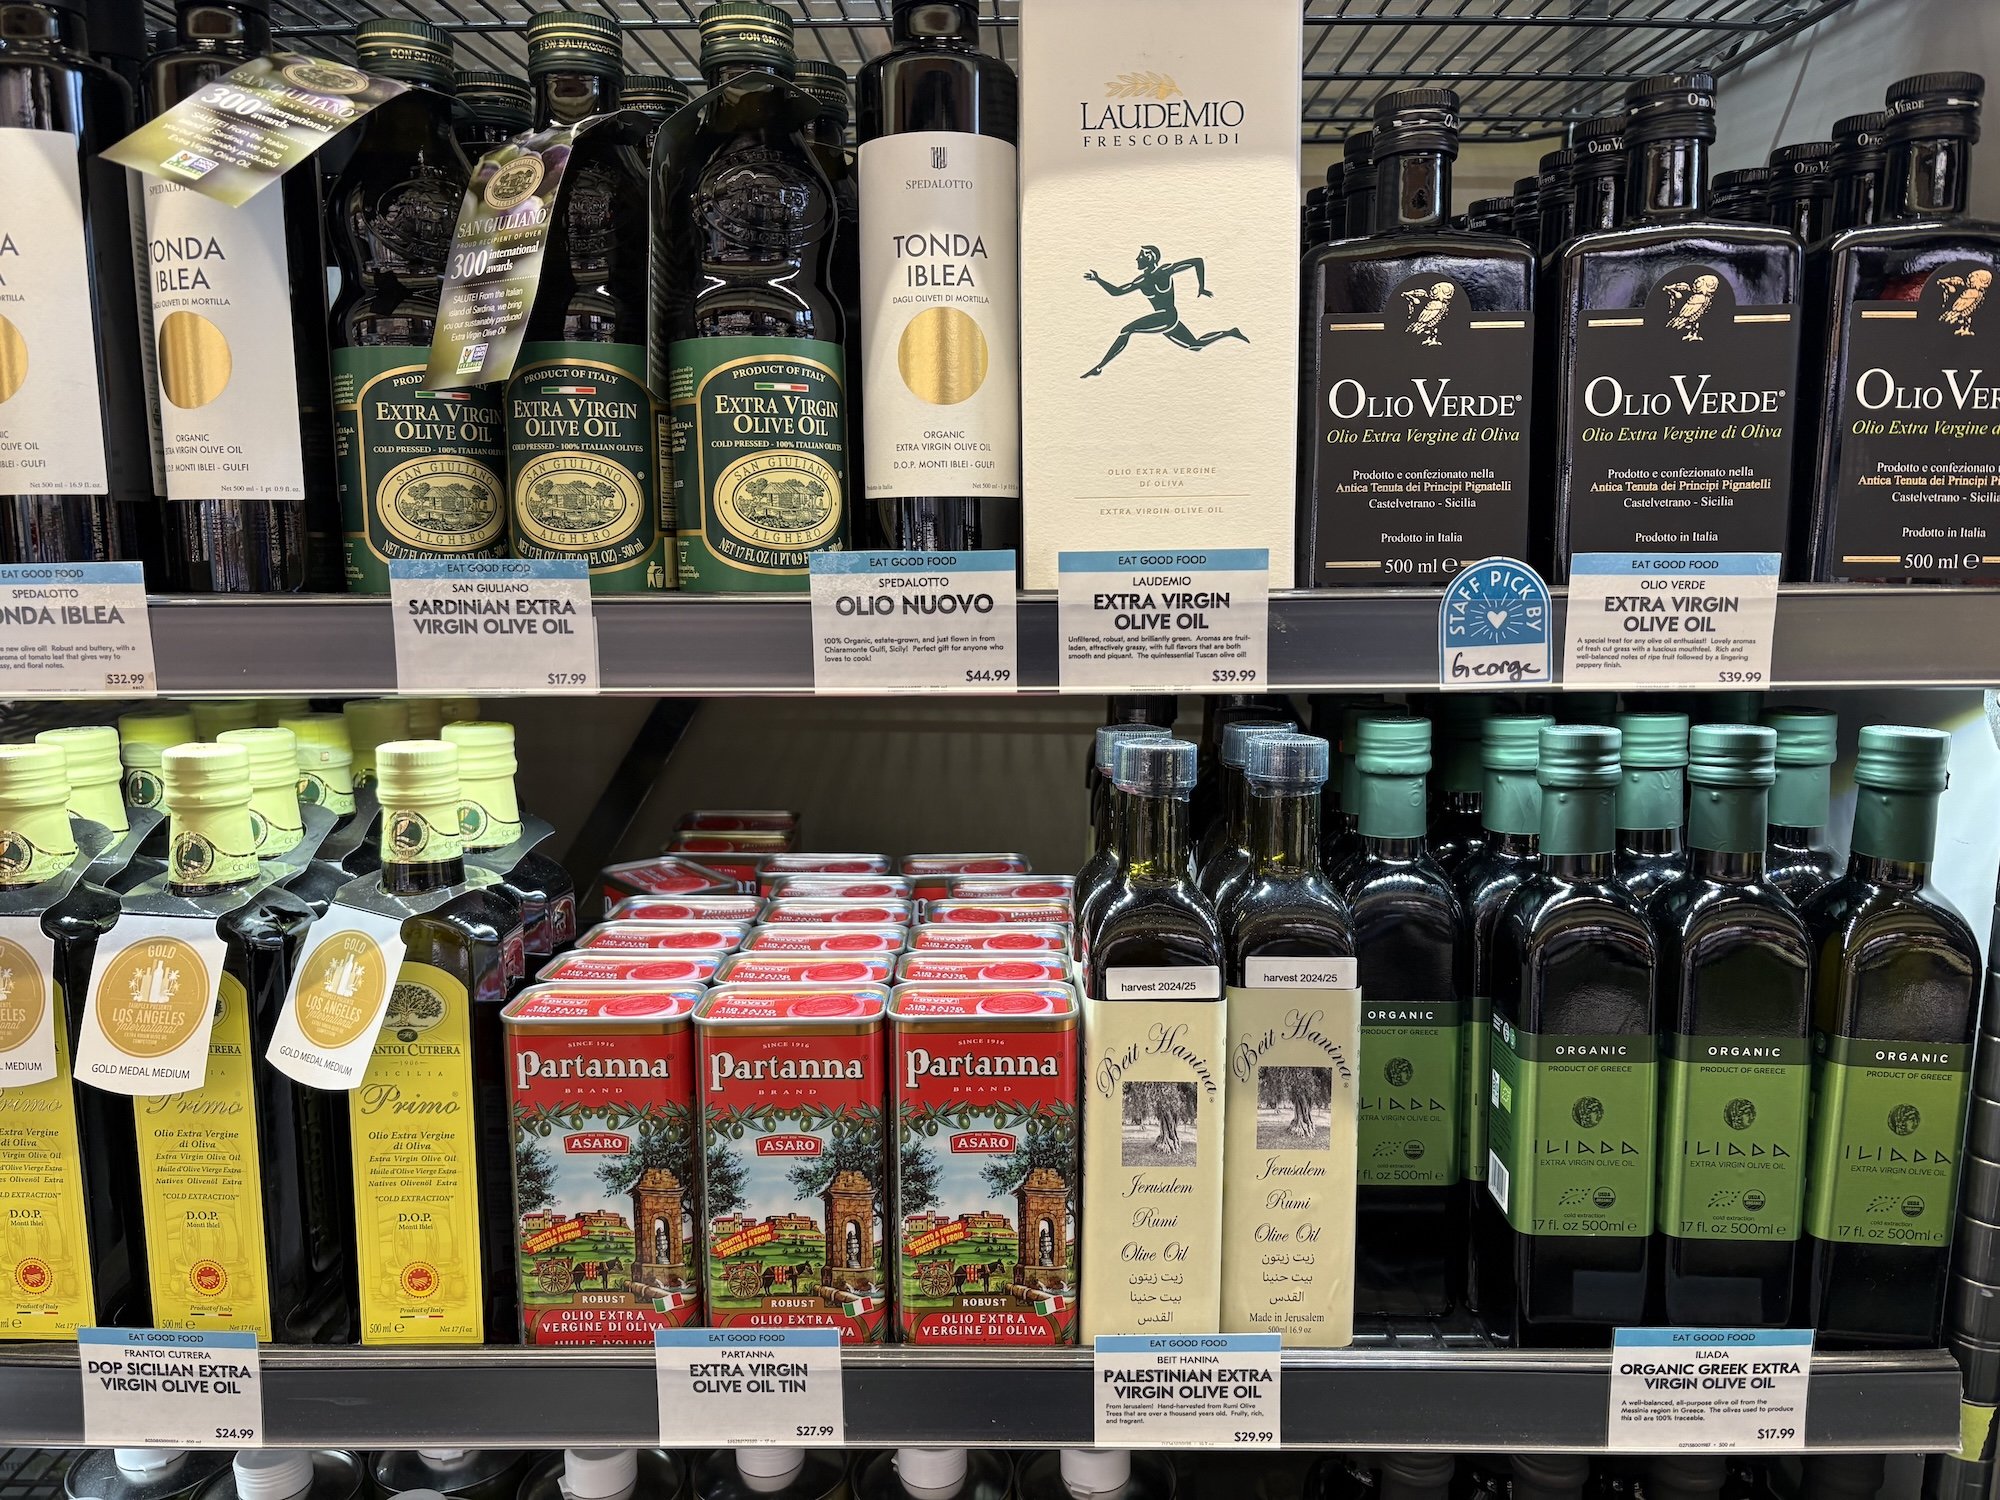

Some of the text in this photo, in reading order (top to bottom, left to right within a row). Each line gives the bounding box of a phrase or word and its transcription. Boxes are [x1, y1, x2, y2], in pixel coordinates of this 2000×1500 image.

[1080, 99, 1245, 130] LAUDEMIO
[1083, 133, 1239, 147] FRESCOBALDI
[905, 179, 973, 190] SPEDALOTTO
[457, 208, 548, 239] SAN GIULIANO
[893, 234, 988, 259] TONDA
[451, 240, 540, 280] 300 international
[486, 259, 514, 274] awards
[907, 264, 975, 288] IBLEA
[892, 294, 990, 305] DAGLI OLIVETI DI MORTILLA
[923, 430, 965, 439] ORGANIC
[1326, 427, 1520, 446] Olio Extra Vergine di Oliva
[870, 556, 957, 567] EAT GOOD FOOD
[1632, 560, 1719, 569] EAT GOOD FOOD
[879, 577, 949, 588] SPEDALOTTO
[1132, 576, 1192, 586] LAUDEMIO
[1640, 580, 1706, 590] OLIO VERDE
[12, 589, 79, 599] SPEDALOTTO
[452, 584, 529, 593] SAN GIULIANO
[409, 599, 576, 615] SARDINIAN EXTRA
[836, 594, 994, 616] OLIO NUOVO
[1094, 592, 1230, 610] EXTRA VIRGIN
[1449, 570, 1542, 635] STAFF PICK BY
[1604, 596, 1739, 613] EXTRA VIRGIN
[62, 605, 125, 625] IBLEA
[1114, 613, 1209, 630] OLIVE OIL
[413, 619, 574, 634] VIRGIN OLIVE OIL
[1623, 616, 1716, 632] OLIVE OIL
[824, 637, 842, 645] 100%
[843, 637, 873, 646] Organic,
[874, 637, 920, 645] estate-grown,
[937, 636, 950, 644] just
[951, 635, 969, 643] flown
[1452, 652, 1540, 681] George
[106, 673, 145, 685] $32.99
[548, 673, 586, 685] $17.99
[966, 669, 1010, 682] $44.99
[1212, 670, 1256, 682] $39.99
[1718, 671, 1761, 683] $39.99
[147, 944, 177, 959] GOLD
[1121, 981, 1196, 992] harvest 2024/25
[112, 1007, 186, 1026] LOS ANGELES
[1368, 1010, 1434, 1020] ORGANIC
[408, 1043, 461, 1056] CUTRERA
[1708, 1046, 1781, 1057] ORGANIC
[1096, 1022, 1217, 1098] Beit Hanina
[1875, 1050, 1949, 1063] ORGANIC
[91, 1063, 190, 1079] GOLD MEDAL MEDIUM
[516, 1049, 669, 1090] Partanna
[905, 1048, 1058, 1089] Partanna
[1700, 1066, 1738, 1074] PRODUCT
[1754, 1067, 1786, 1075] GREECE
[360, 1084, 461, 1115] Primo
[368, 1131, 455, 1142] Olio Extra Vergine
[957, 1136, 1008, 1148] ASARO
[393, 1141, 431, 1150] di Oliva
[571, 1138, 622, 1150] ASARO
[1121, 1172, 1194, 1198] Jerusalem
[398, 1213, 432, 1222] D.O.P.
[1132, 1206, 1178, 1229] Rumi
[1681, 1221, 1774, 1235] 17 fl. oz 500ml
[1120, 1241, 1187, 1262] Olive Oil
[1129, 1272, 1184, 1285] زيت زيتون
[582, 1295, 626, 1304] ROBUST
[1130, 1291, 1182, 1304] بيت حنينا
[1137, 1311, 1173, 1326] القدس
[1672, 1334, 1690, 1342] EAT
[1727, 1333, 1755, 1341] FOOD
[124, 1349, 211, 1359] FRANTOI CUTRERA
[721, 1350, 775, 1359] PARTANNA
[1157, 1356, 1219, 1364] BEIT HANINA
[88, 1361, 252, 1378] DOP SICILIAN EXTRA
[689, 1363, 808, 1377] EXTRA VIRGIN
[1620, 1362, 1800, 1375] ORGANIC GREEK EXTRA
[1104, 1369, 1273, 1383] PALESTINIAN EXTRA
[100, 1377, 241, 1394] VIRGIN OLIVE OIL
[692, 1380, 806, 1393] OLIVE OIL TIN
[1644, 1377, 1775, 1389] VIRGIN OLIVE OIL
[1114, 1386, 1262, 1399] VIRGIN OLIVE OIL
[215, 1428, 254, 1439] $24.99
[796, 1426, 834, 1437] $27.99
[1234, 1431, 1273, 1442] $29.99
[1757, 1428, 1795, 1440] $17.99
